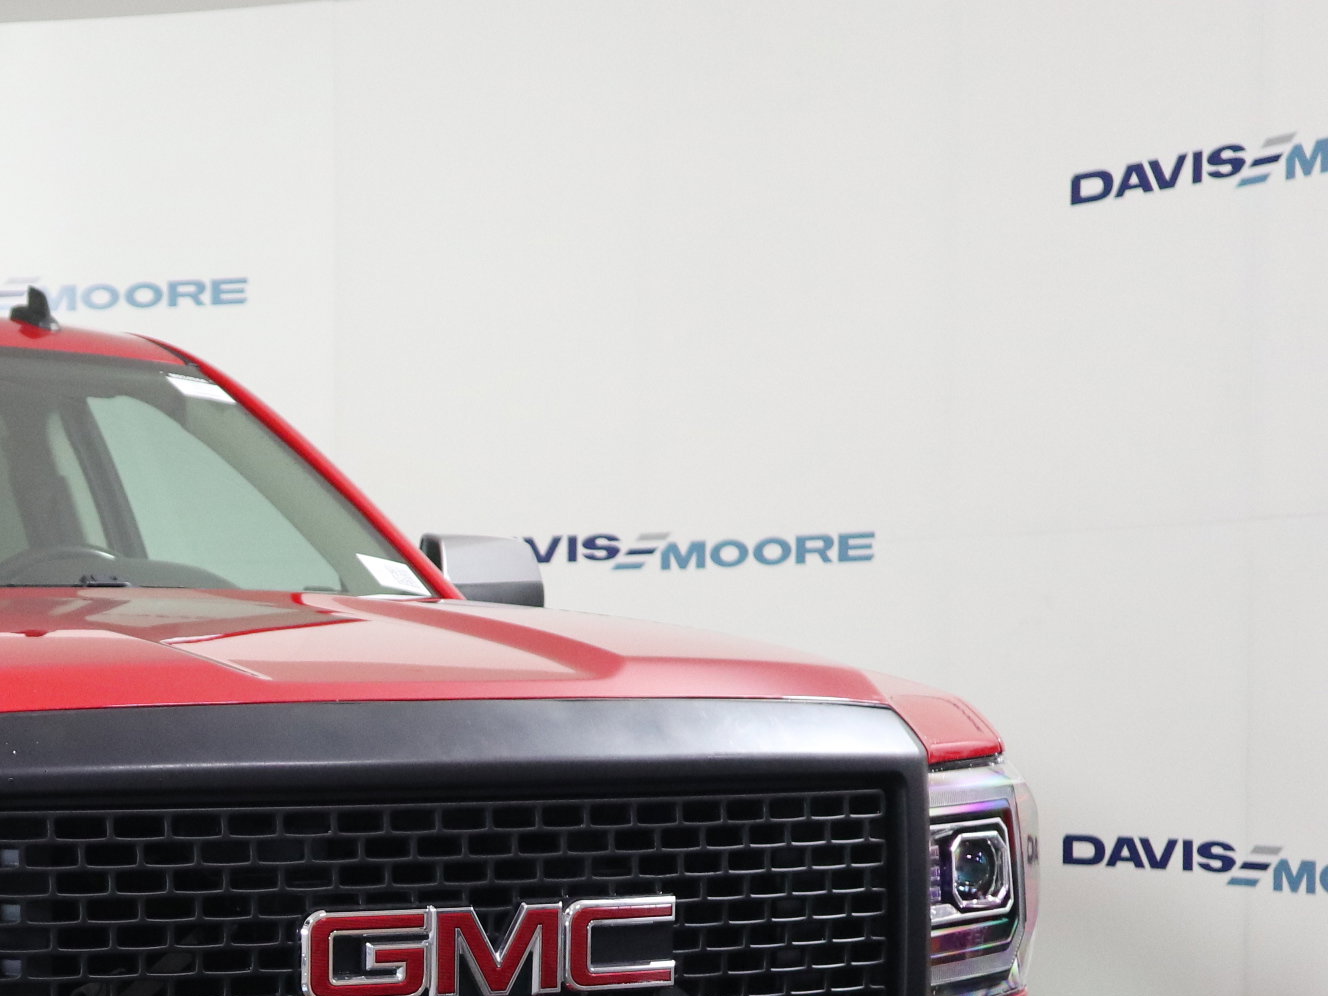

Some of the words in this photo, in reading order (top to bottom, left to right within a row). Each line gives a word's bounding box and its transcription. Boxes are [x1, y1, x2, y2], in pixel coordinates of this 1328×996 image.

[1070, 143, 1247, 206] DAVIS
[522, 533, 621, 563] VIS
[660, 532, 875, 571] MOORE
[1062, 833, 1237, 874] DAVIS
